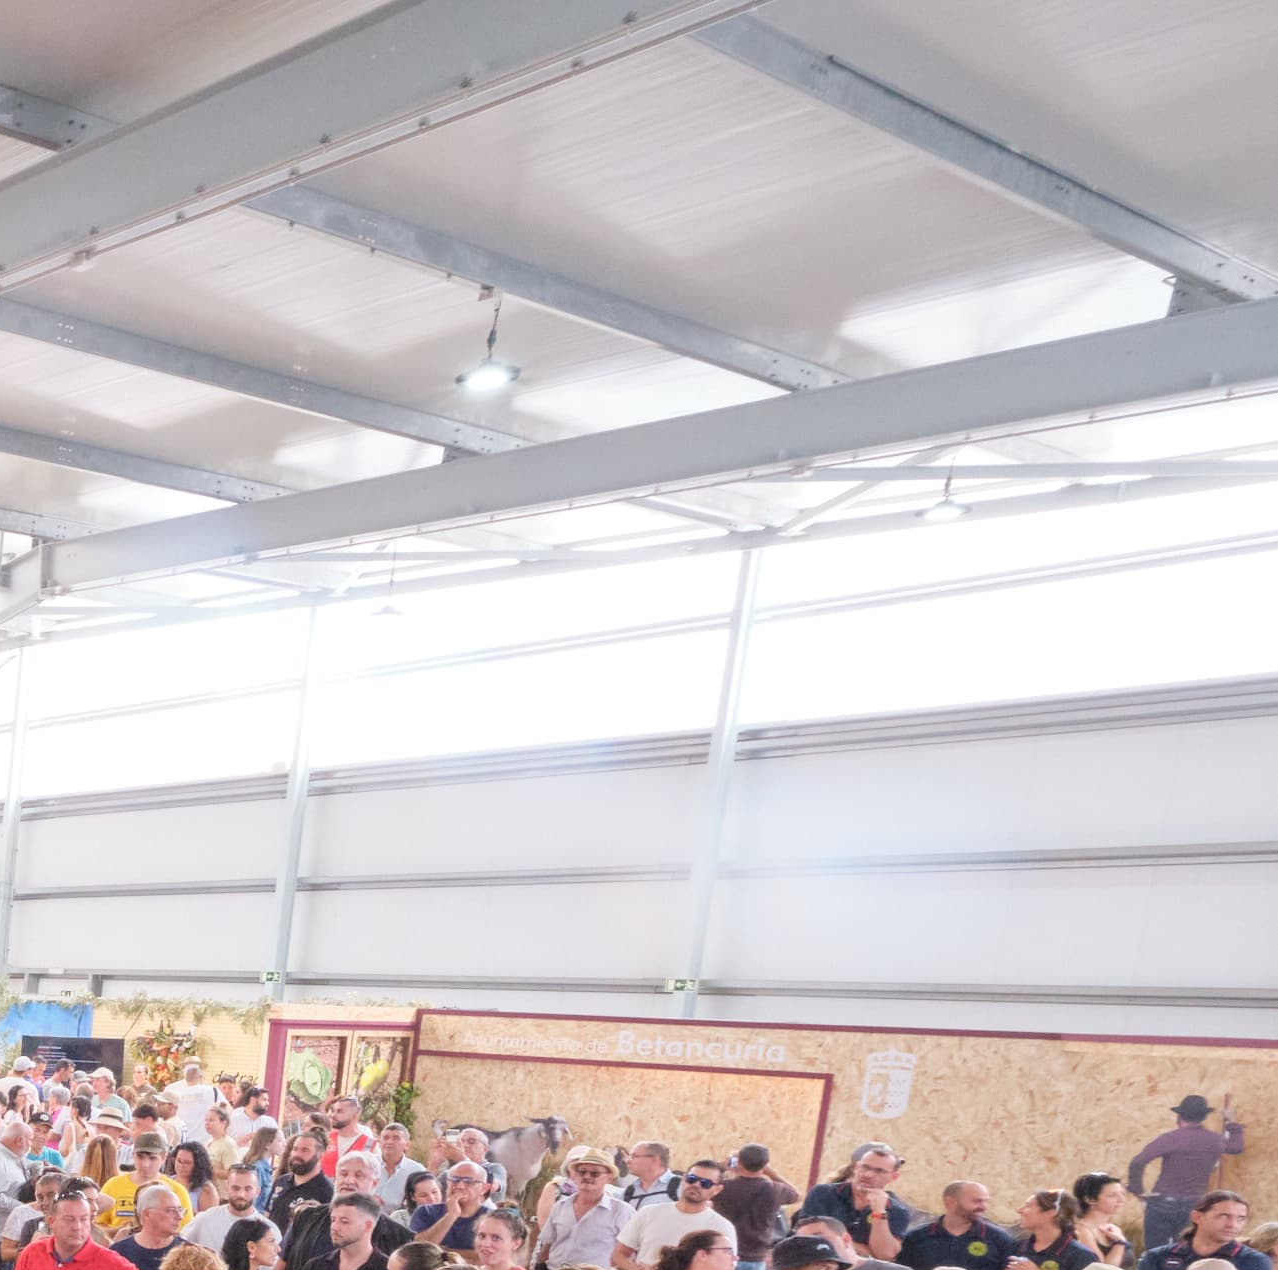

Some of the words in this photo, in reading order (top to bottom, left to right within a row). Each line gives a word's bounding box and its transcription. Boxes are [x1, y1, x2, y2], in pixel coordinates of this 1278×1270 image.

[463, 1031, 577, 1052] Ayuntamiento
[588, 1038, 609, 1052] de
[615, 1030, 787, 1064] Betancuria
